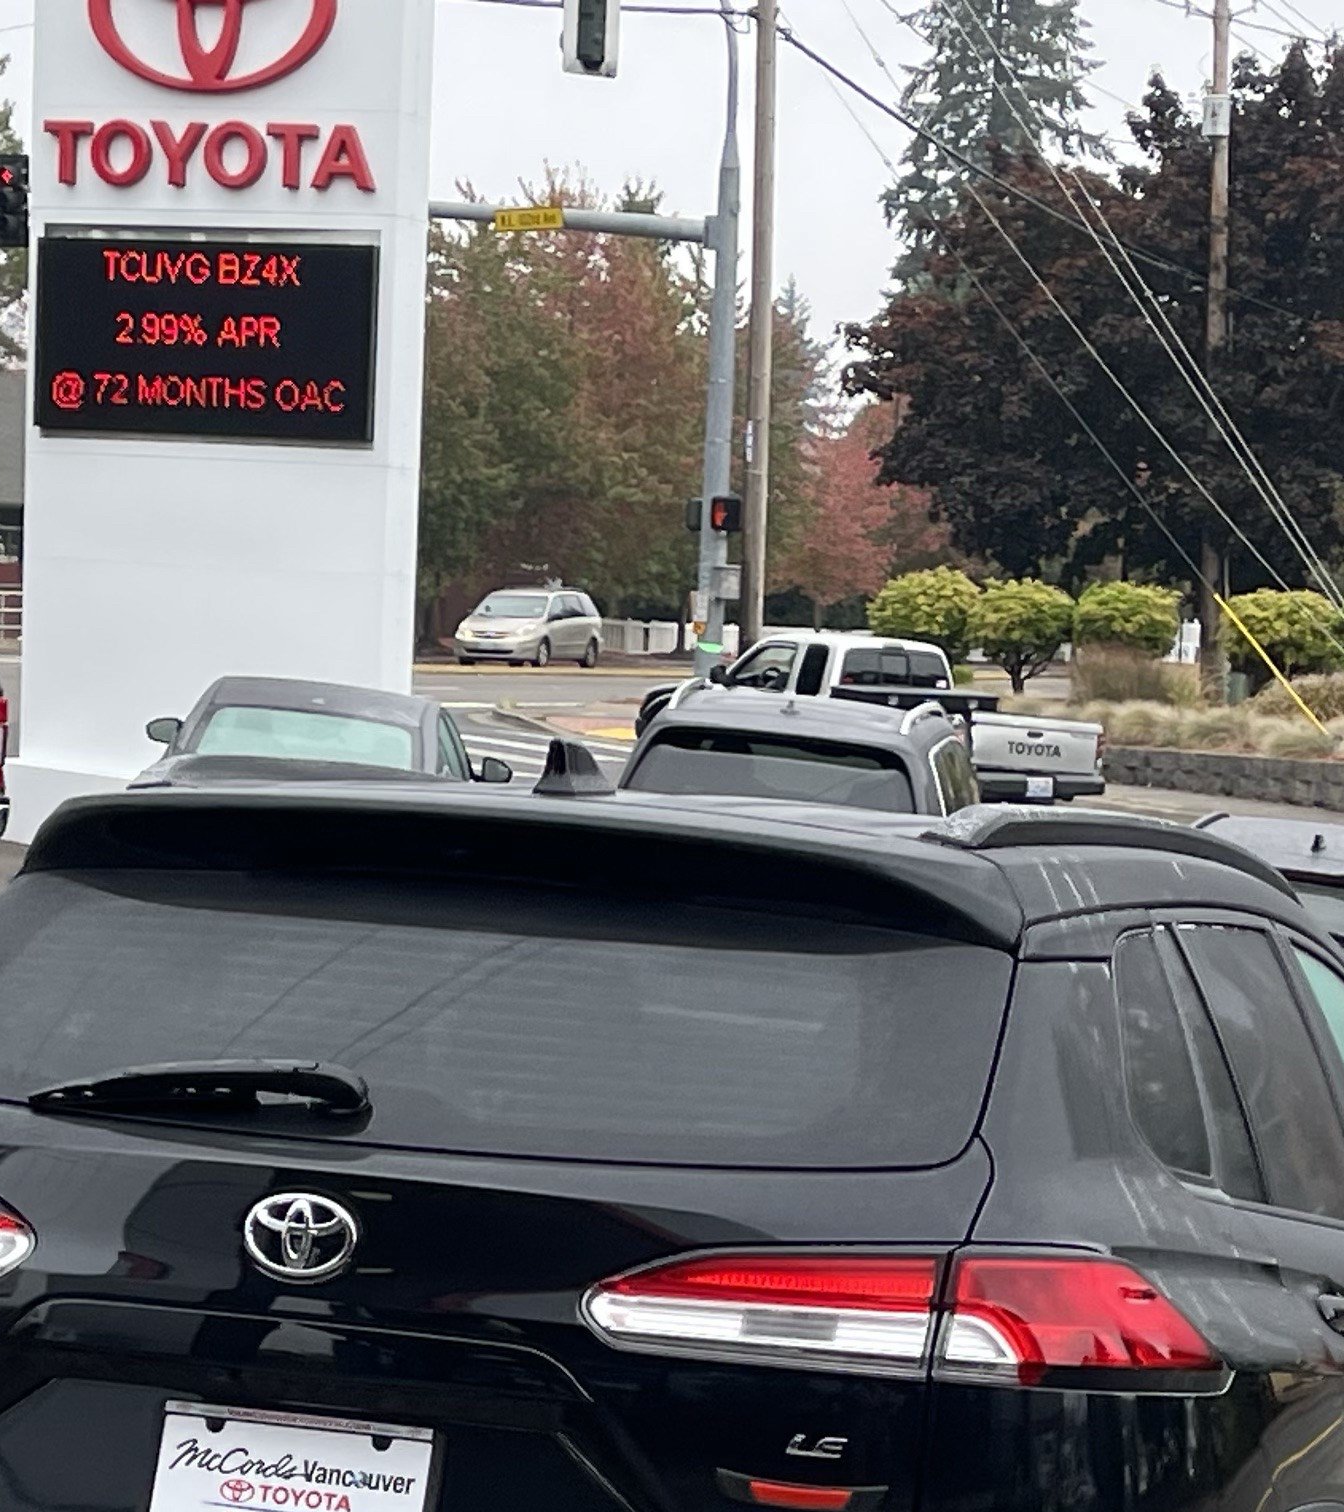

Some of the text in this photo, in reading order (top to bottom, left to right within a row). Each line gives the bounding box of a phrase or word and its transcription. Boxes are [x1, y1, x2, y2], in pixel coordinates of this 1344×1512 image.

[44, 118, 376, 194] TOYOTA
[103, 249, 302, 287] TCUVG BZ4X
[115, 311, 282, 348] 2.99% APR
[50, 370, 347, 413] @ 72 MONTHS OAC
[1007, 740, 1062, 758] TOYOTA
[785, 1433, 849, 1459] LE
[168, 1438, 416, 1495] McCords Vancouver
[260, 1484, 352, 1512] TOYOTA
